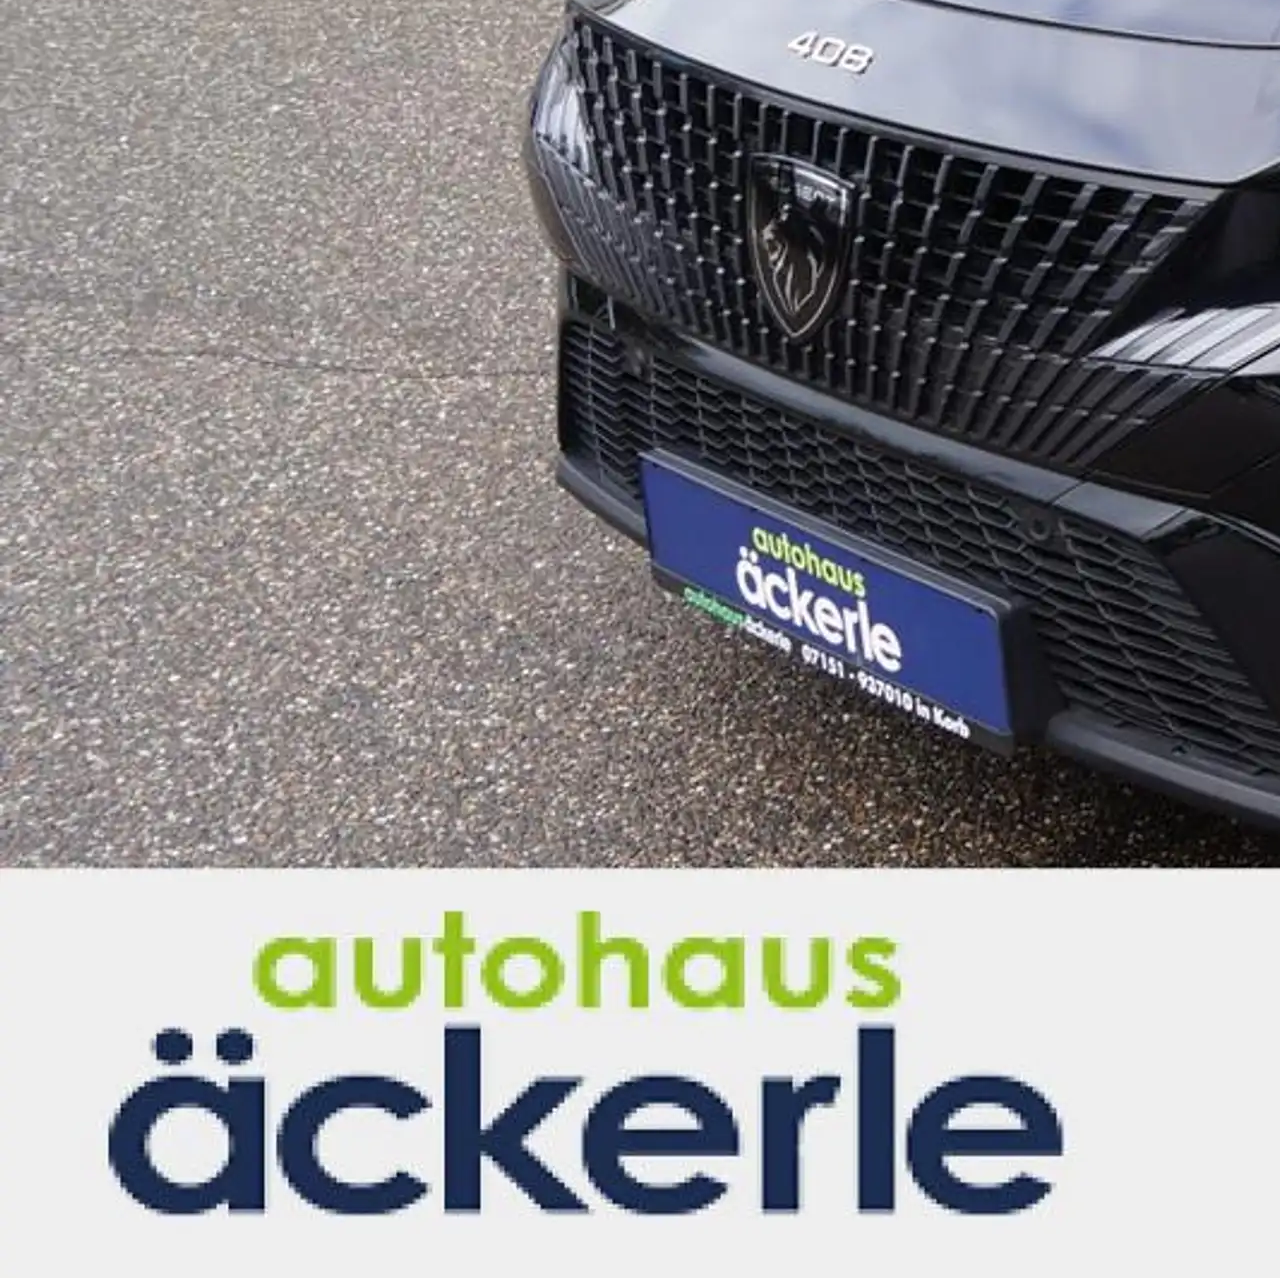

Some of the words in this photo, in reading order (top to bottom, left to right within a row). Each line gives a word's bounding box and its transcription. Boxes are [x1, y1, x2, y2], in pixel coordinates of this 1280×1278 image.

[787, 31, 874, 75] 408
[752, 527, 866, 598] autohaus
[736, 545, 902, 672] äckerle
[801, 644, 844, 679] 07151
[857, 671, 913, 712] 937010
[916, 696, 931, 722] in
